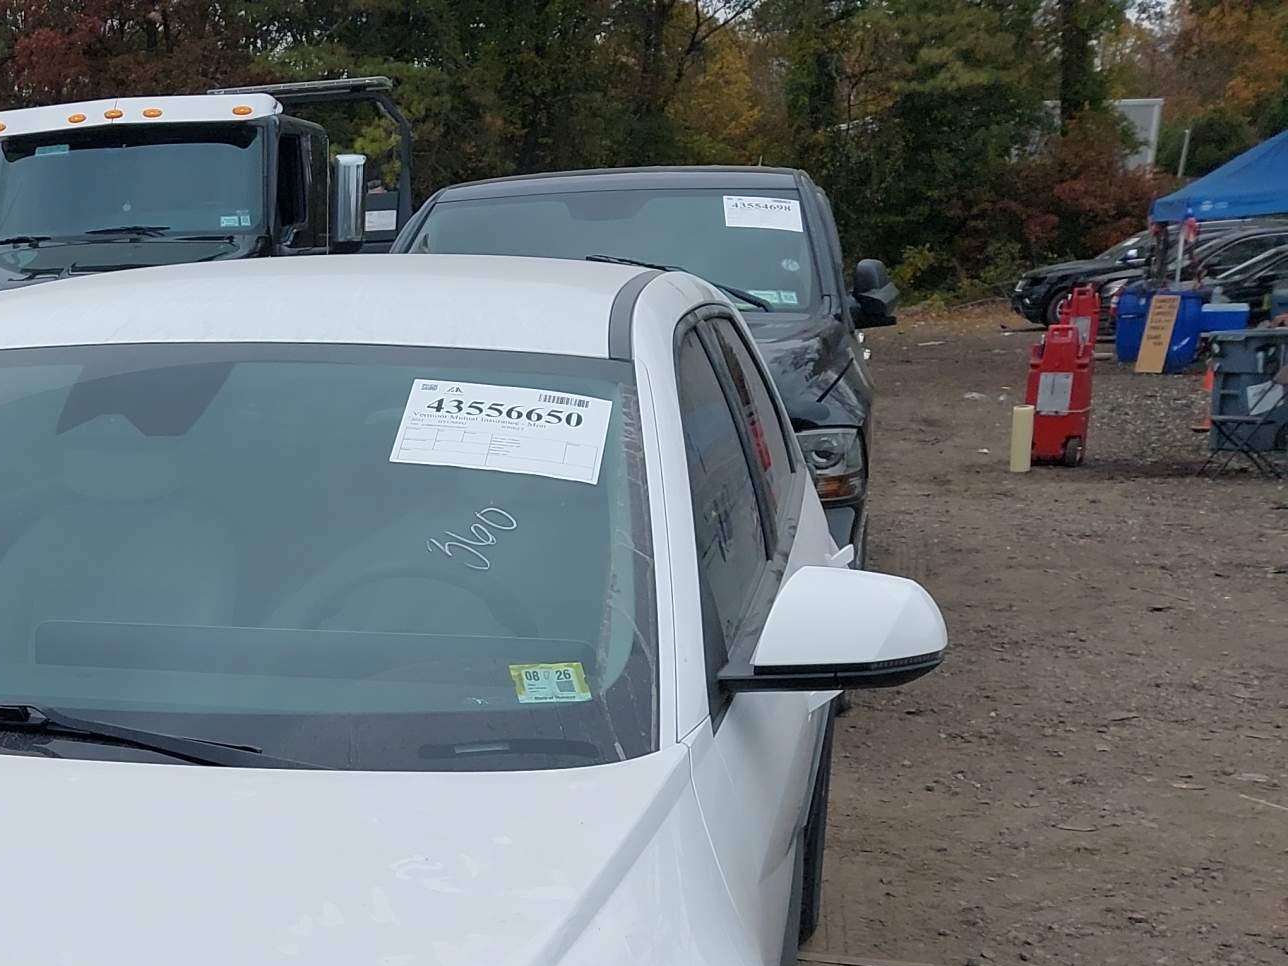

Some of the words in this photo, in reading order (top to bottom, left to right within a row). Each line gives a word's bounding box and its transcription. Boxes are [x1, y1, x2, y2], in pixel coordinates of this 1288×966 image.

[426, 397, 583, 428] 43556650
[425, 507, 518, 570] 360
[524, 670, 540, 681] 08
[555, 669, 572, 680] 26
